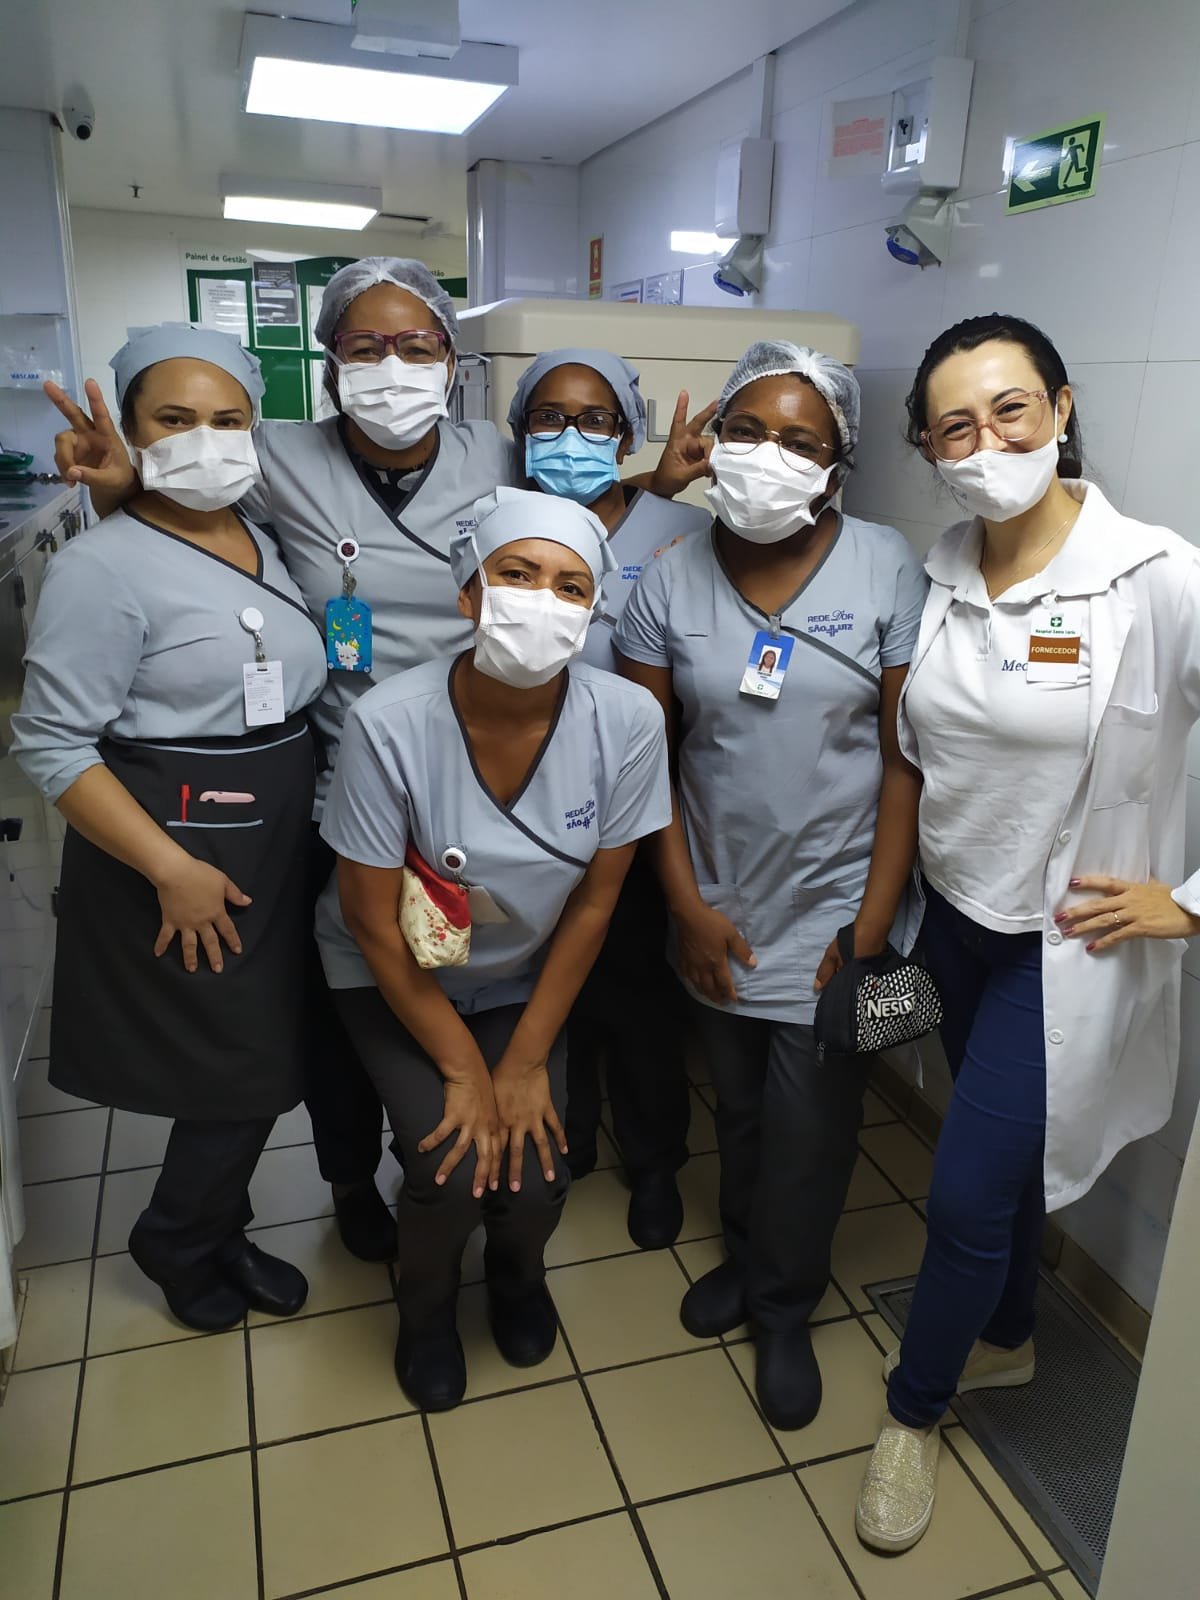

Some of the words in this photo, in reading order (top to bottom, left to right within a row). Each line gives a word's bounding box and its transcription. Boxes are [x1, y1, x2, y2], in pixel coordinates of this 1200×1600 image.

[185, 252, 208, 261] Painel
[211, 253, 219, 262] de
[222, 255, 247, 264] Gestão
[808, 614, 830, 622] REDE
[808, 624, 826, 633] SÃO
[1031, 646, 1077, 655] FORNECEDOR
[565, 807, 584, 818] REDE
[566, 819, 582, 830] SÃO
